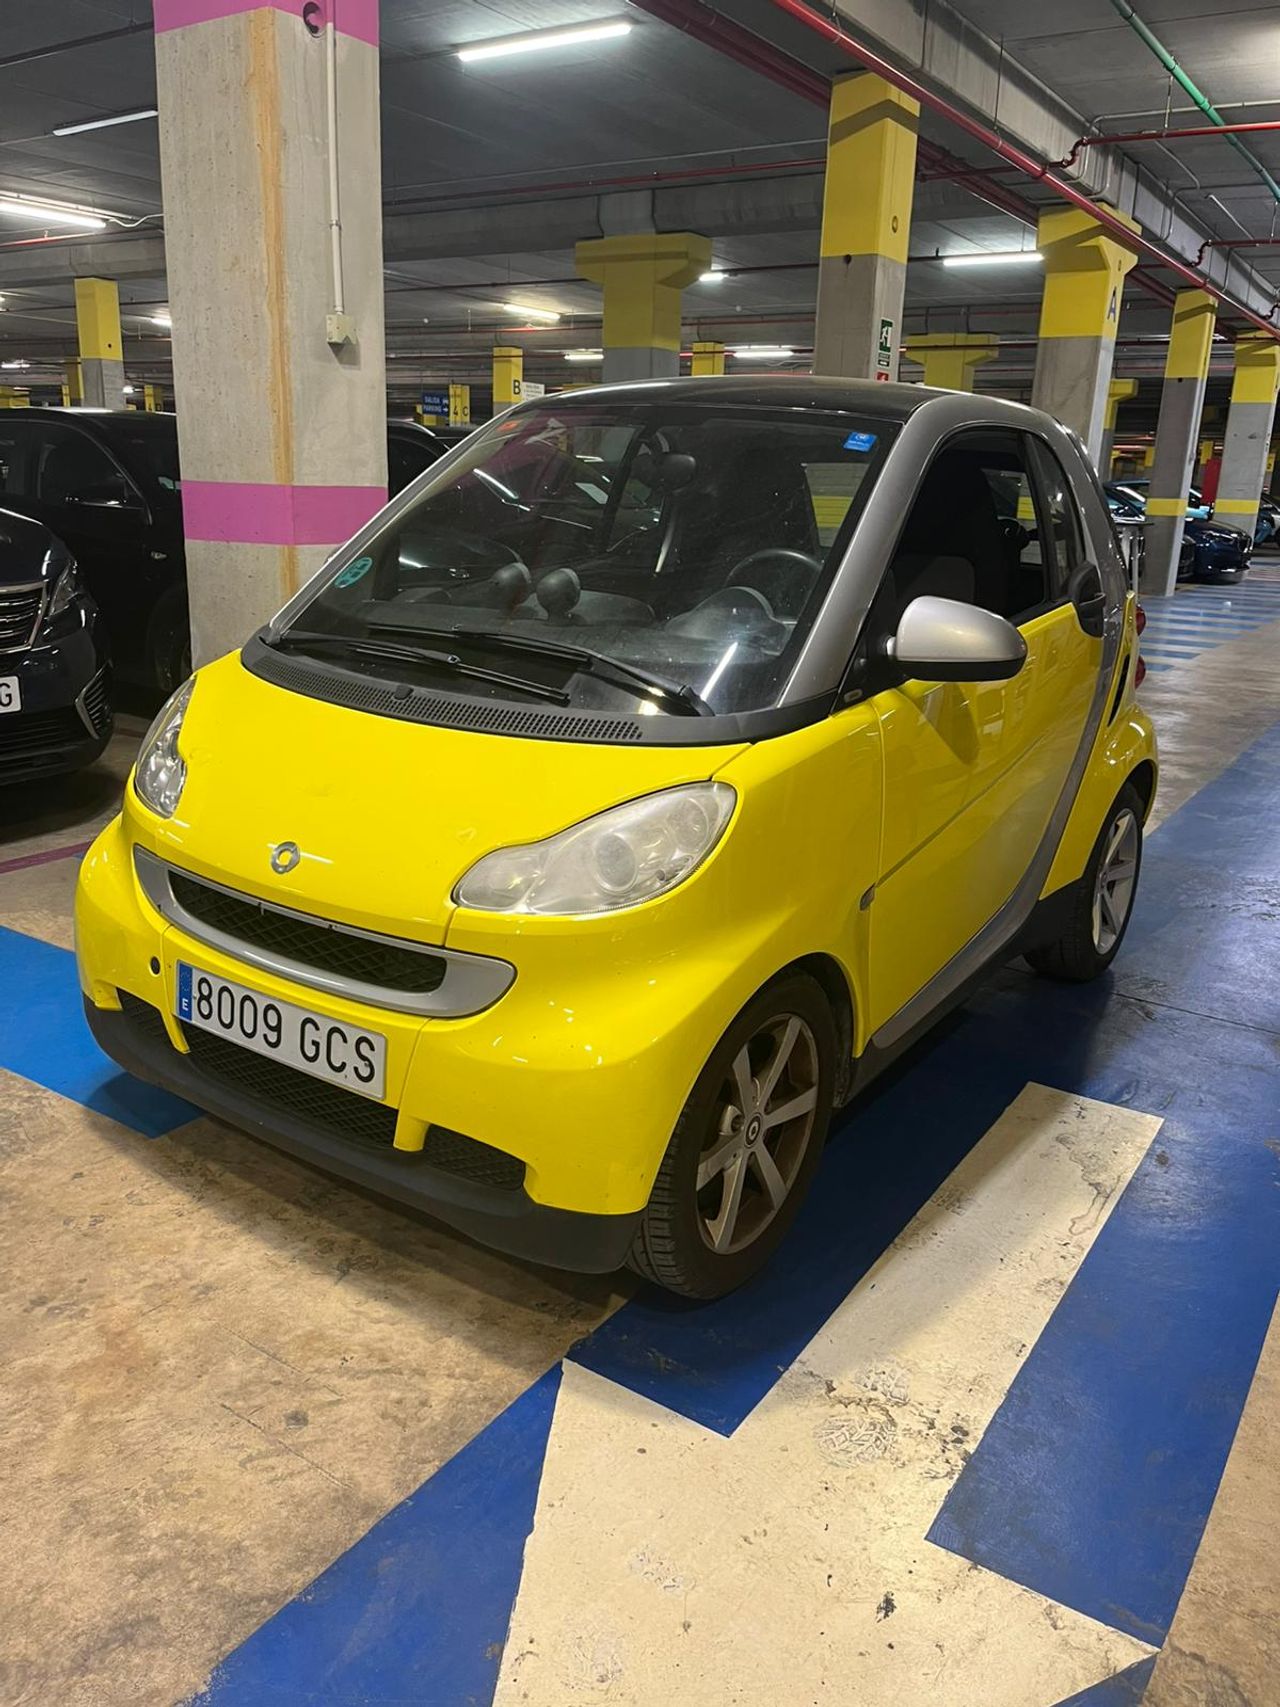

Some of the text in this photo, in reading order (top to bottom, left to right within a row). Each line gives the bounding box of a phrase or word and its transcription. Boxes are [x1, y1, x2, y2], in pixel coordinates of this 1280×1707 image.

[1107, 286, 1117, 323] A
[513, 379, 521, 395] B
[0, 683, 12, 707] G
[182, 997, 189, 1012] E
[196, 976, 376, 1083] 8009 GCS
